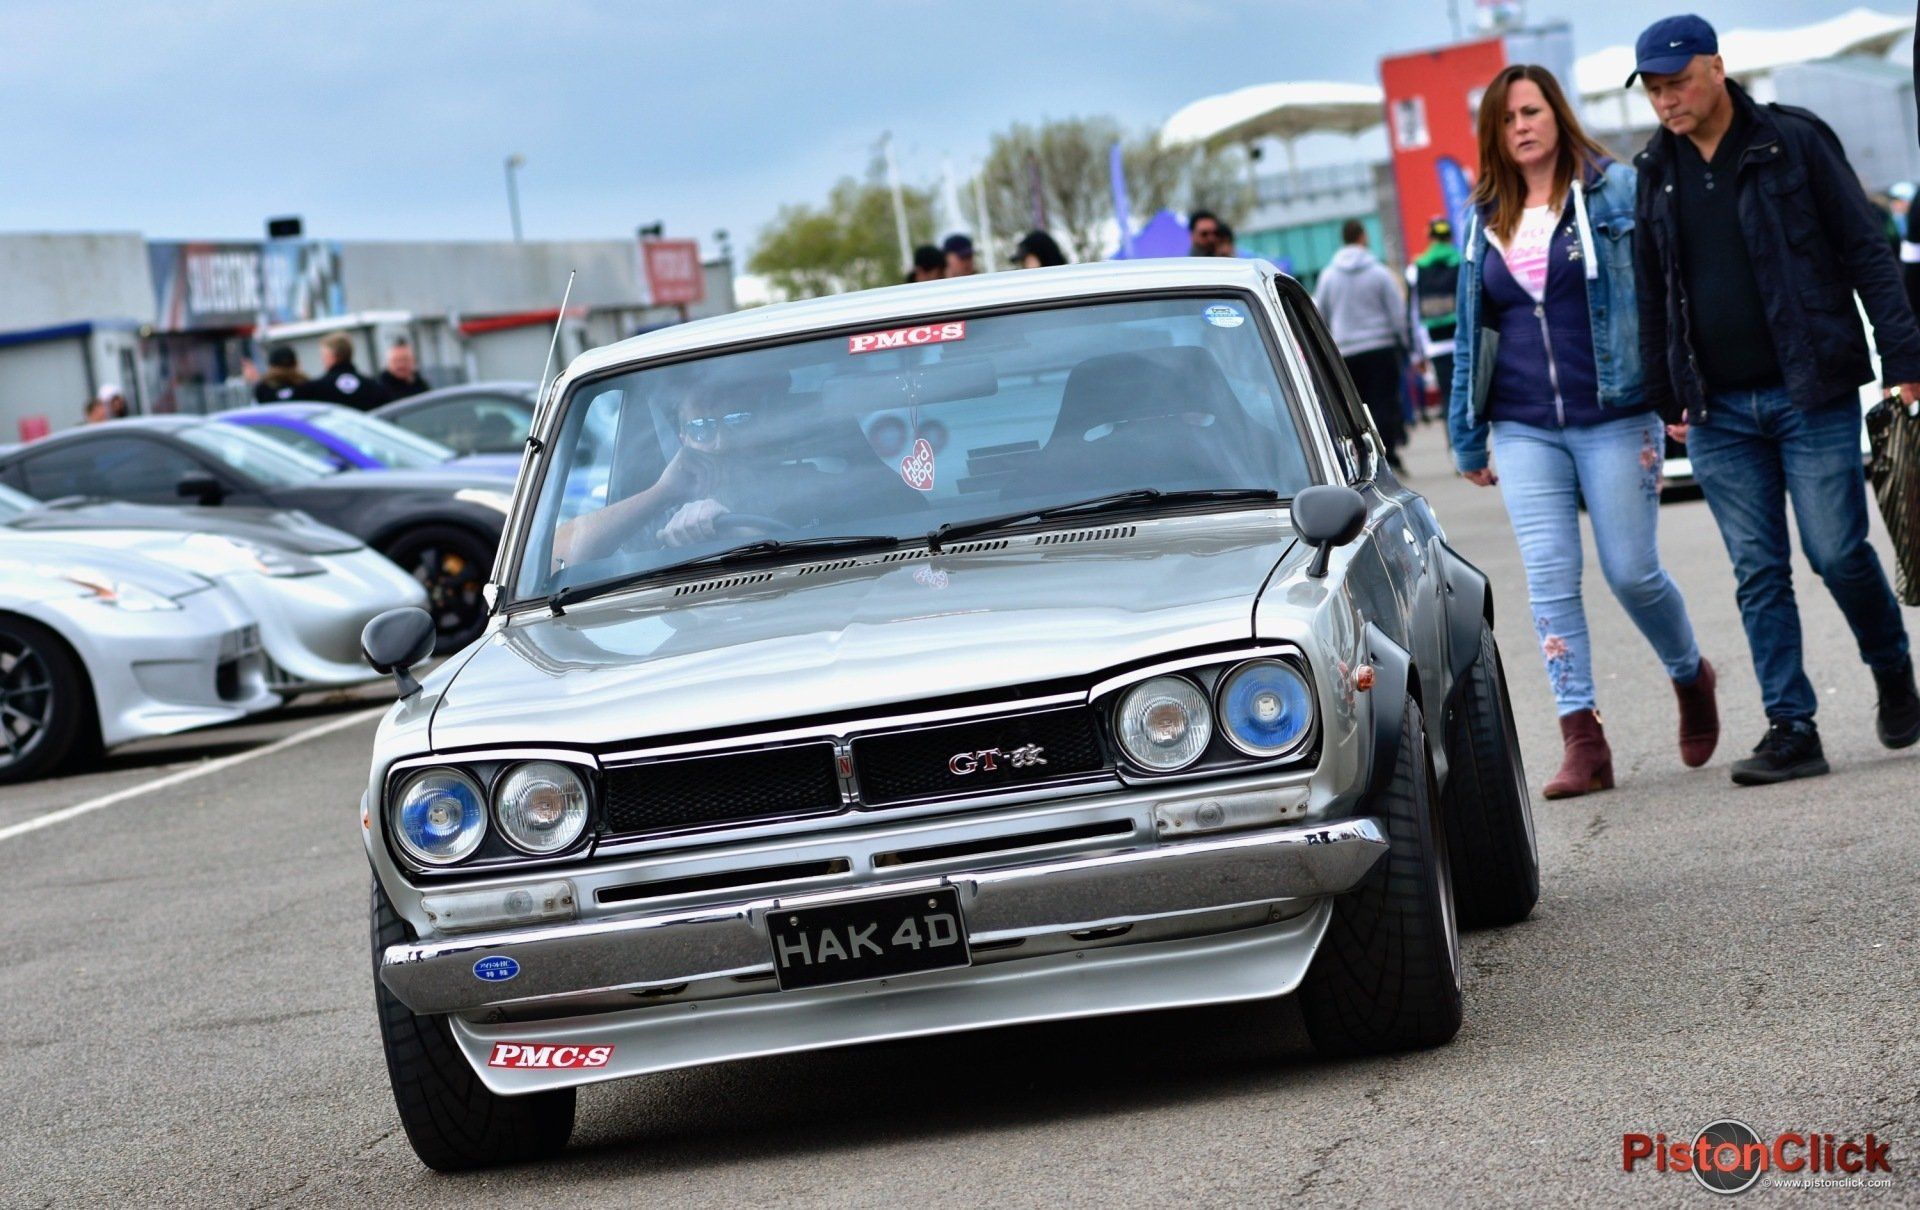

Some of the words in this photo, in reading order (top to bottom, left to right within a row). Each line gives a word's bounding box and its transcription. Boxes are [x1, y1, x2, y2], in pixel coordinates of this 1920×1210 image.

[902, 441, 930, 481] Hard
[911, 461, 932, 487] top
[776, 922, 884, 968] HAK
[891, 913, 958, 950] 4D
